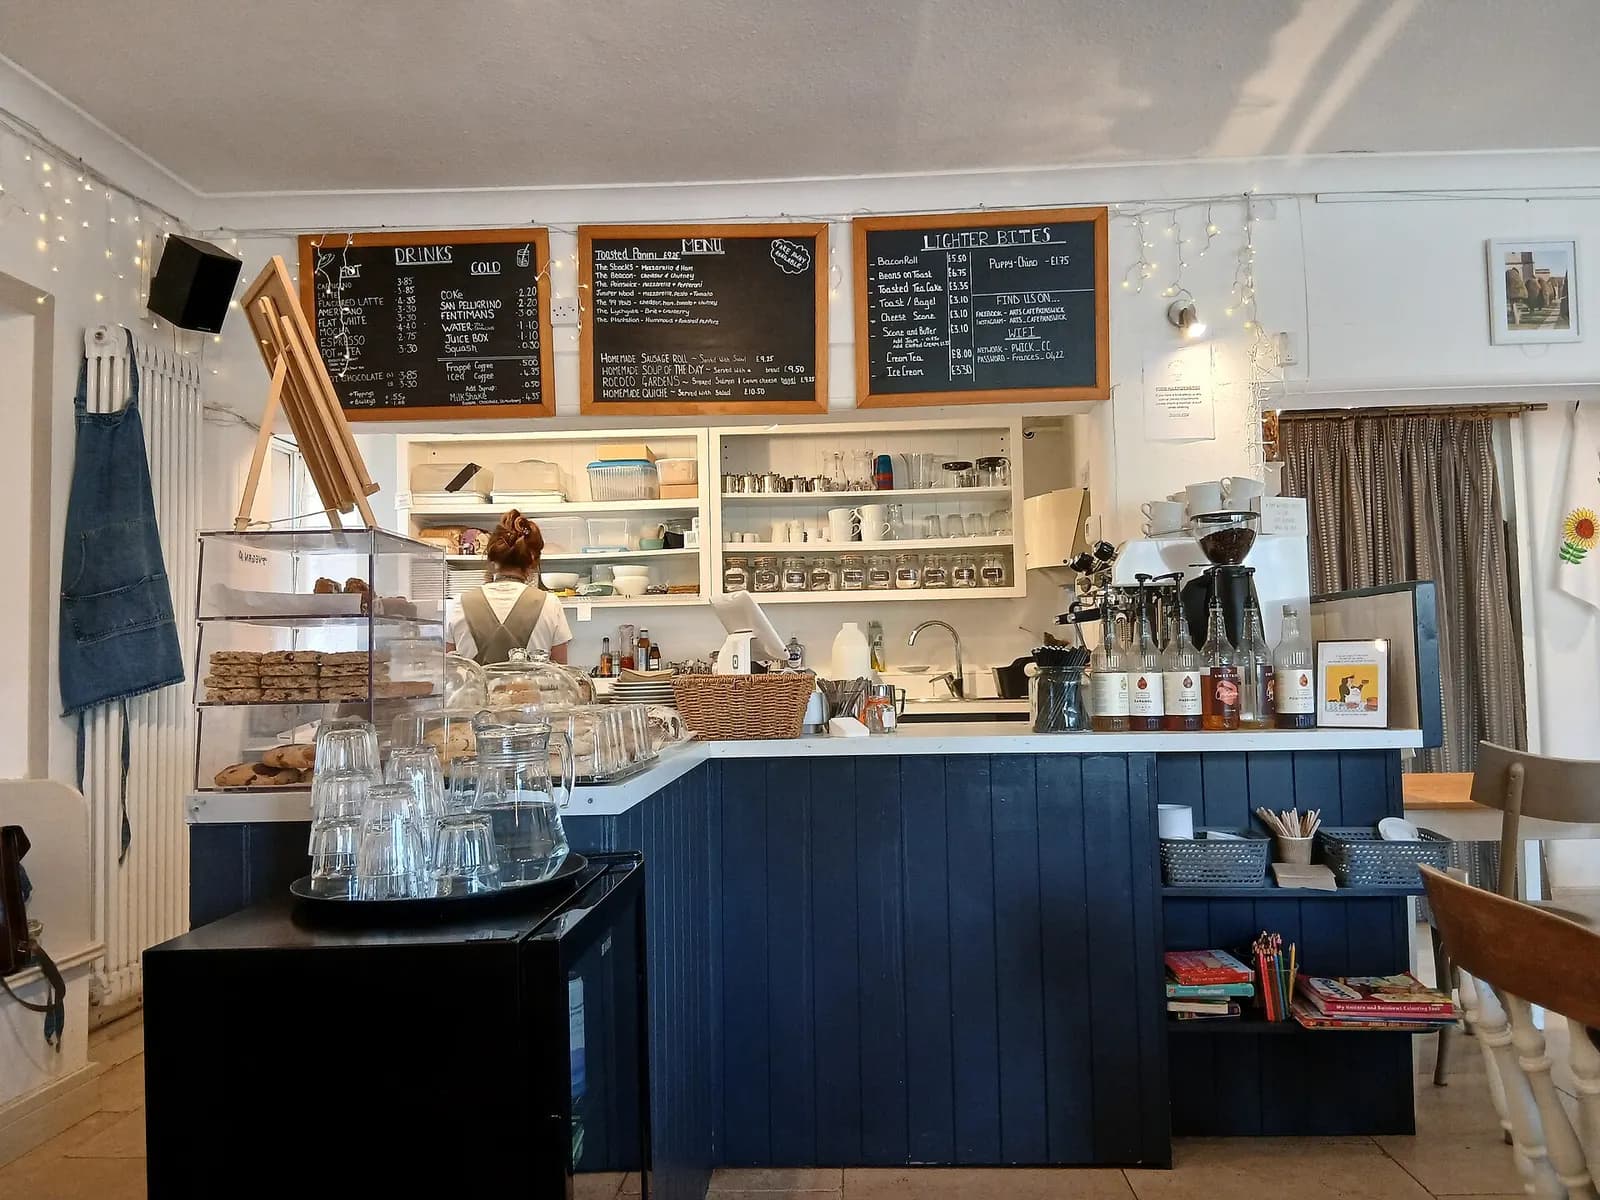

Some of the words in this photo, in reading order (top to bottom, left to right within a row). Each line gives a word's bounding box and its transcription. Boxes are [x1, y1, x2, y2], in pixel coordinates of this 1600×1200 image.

[923, 231, 989, 249] LIGHTER
[997, 227, 1051, 245] BITES
[681, 238, 722, 253] MENU
[395, 246, 453, 263] DRINKS
[595, 247, 627, 259] Toasted
[632, 247, 657, 259] Panini
[877, 256, 904, 266] Bacon
[904, 255, 918, 265] Roll
[989, 255, 1038, 269] Puppy-Chino
[471, 261, 501, 274] COLD
[878, 271, 901, 280] Beans
[912, 270, 932, 278] Toast
[877, 282, 909, 294] Toasted
[912, 283, 926, 292] Tea
[926, 282, 943, 292] Cake
[949, 281, 969, 291] £3.35
[358, 297, 384, 306] LATTE
[879, 297, 904, 307] Toast
[914, 296, 936, 310] Bagel
[949, 295, 968, 304] £3.10
[996, 294, 1020, 305] FIND
[1023, 294, 1036, 304] US
[440, 301, 455, 310] SAN
[440, 309, 495, 320] FENTIMANS
[881, 312, 907, 322] Cheese
[913, 311, 936, 320] Scone
[949, 309, 968, 319] £3.10
[319, 318, 337, 327] FLAT
[441, 322, 472, 332] WATER
[882, 326, 904, 337] Scone
[950, 324, 969, 334] £3.10
[1007, 326, 1036, 339] WIFI
[445, 334, 470, 344] JUICE
[472, 333, 489, 343] BOX
[322, 348, 336, 358] POT
[445, 344, 478, 356] Squash
[886, 352, 907, 362] Cream
[907, 351, 924, 361] Tea
[951, 348, 972, 358] £8.00
[672, 353, 688, 364] ROLL
[602, 365, 639, 375] HOMEMADE
[641, 364, 663, 375] SOUP
[663, 365, 672, 374] OF
[674, 364, 687, 375] THE
[688, 364, 704, 375] DAY
[886, 366, 900, 376] Ice
[902, 365, 924, 376] Cream
[602, 376, 636, 387] ROCOCO
[641, 375, 680, 387] GARDENS
[602, 388, 640, 398] HOMEMADE
[642, 388, 668, 398] QUICHE
